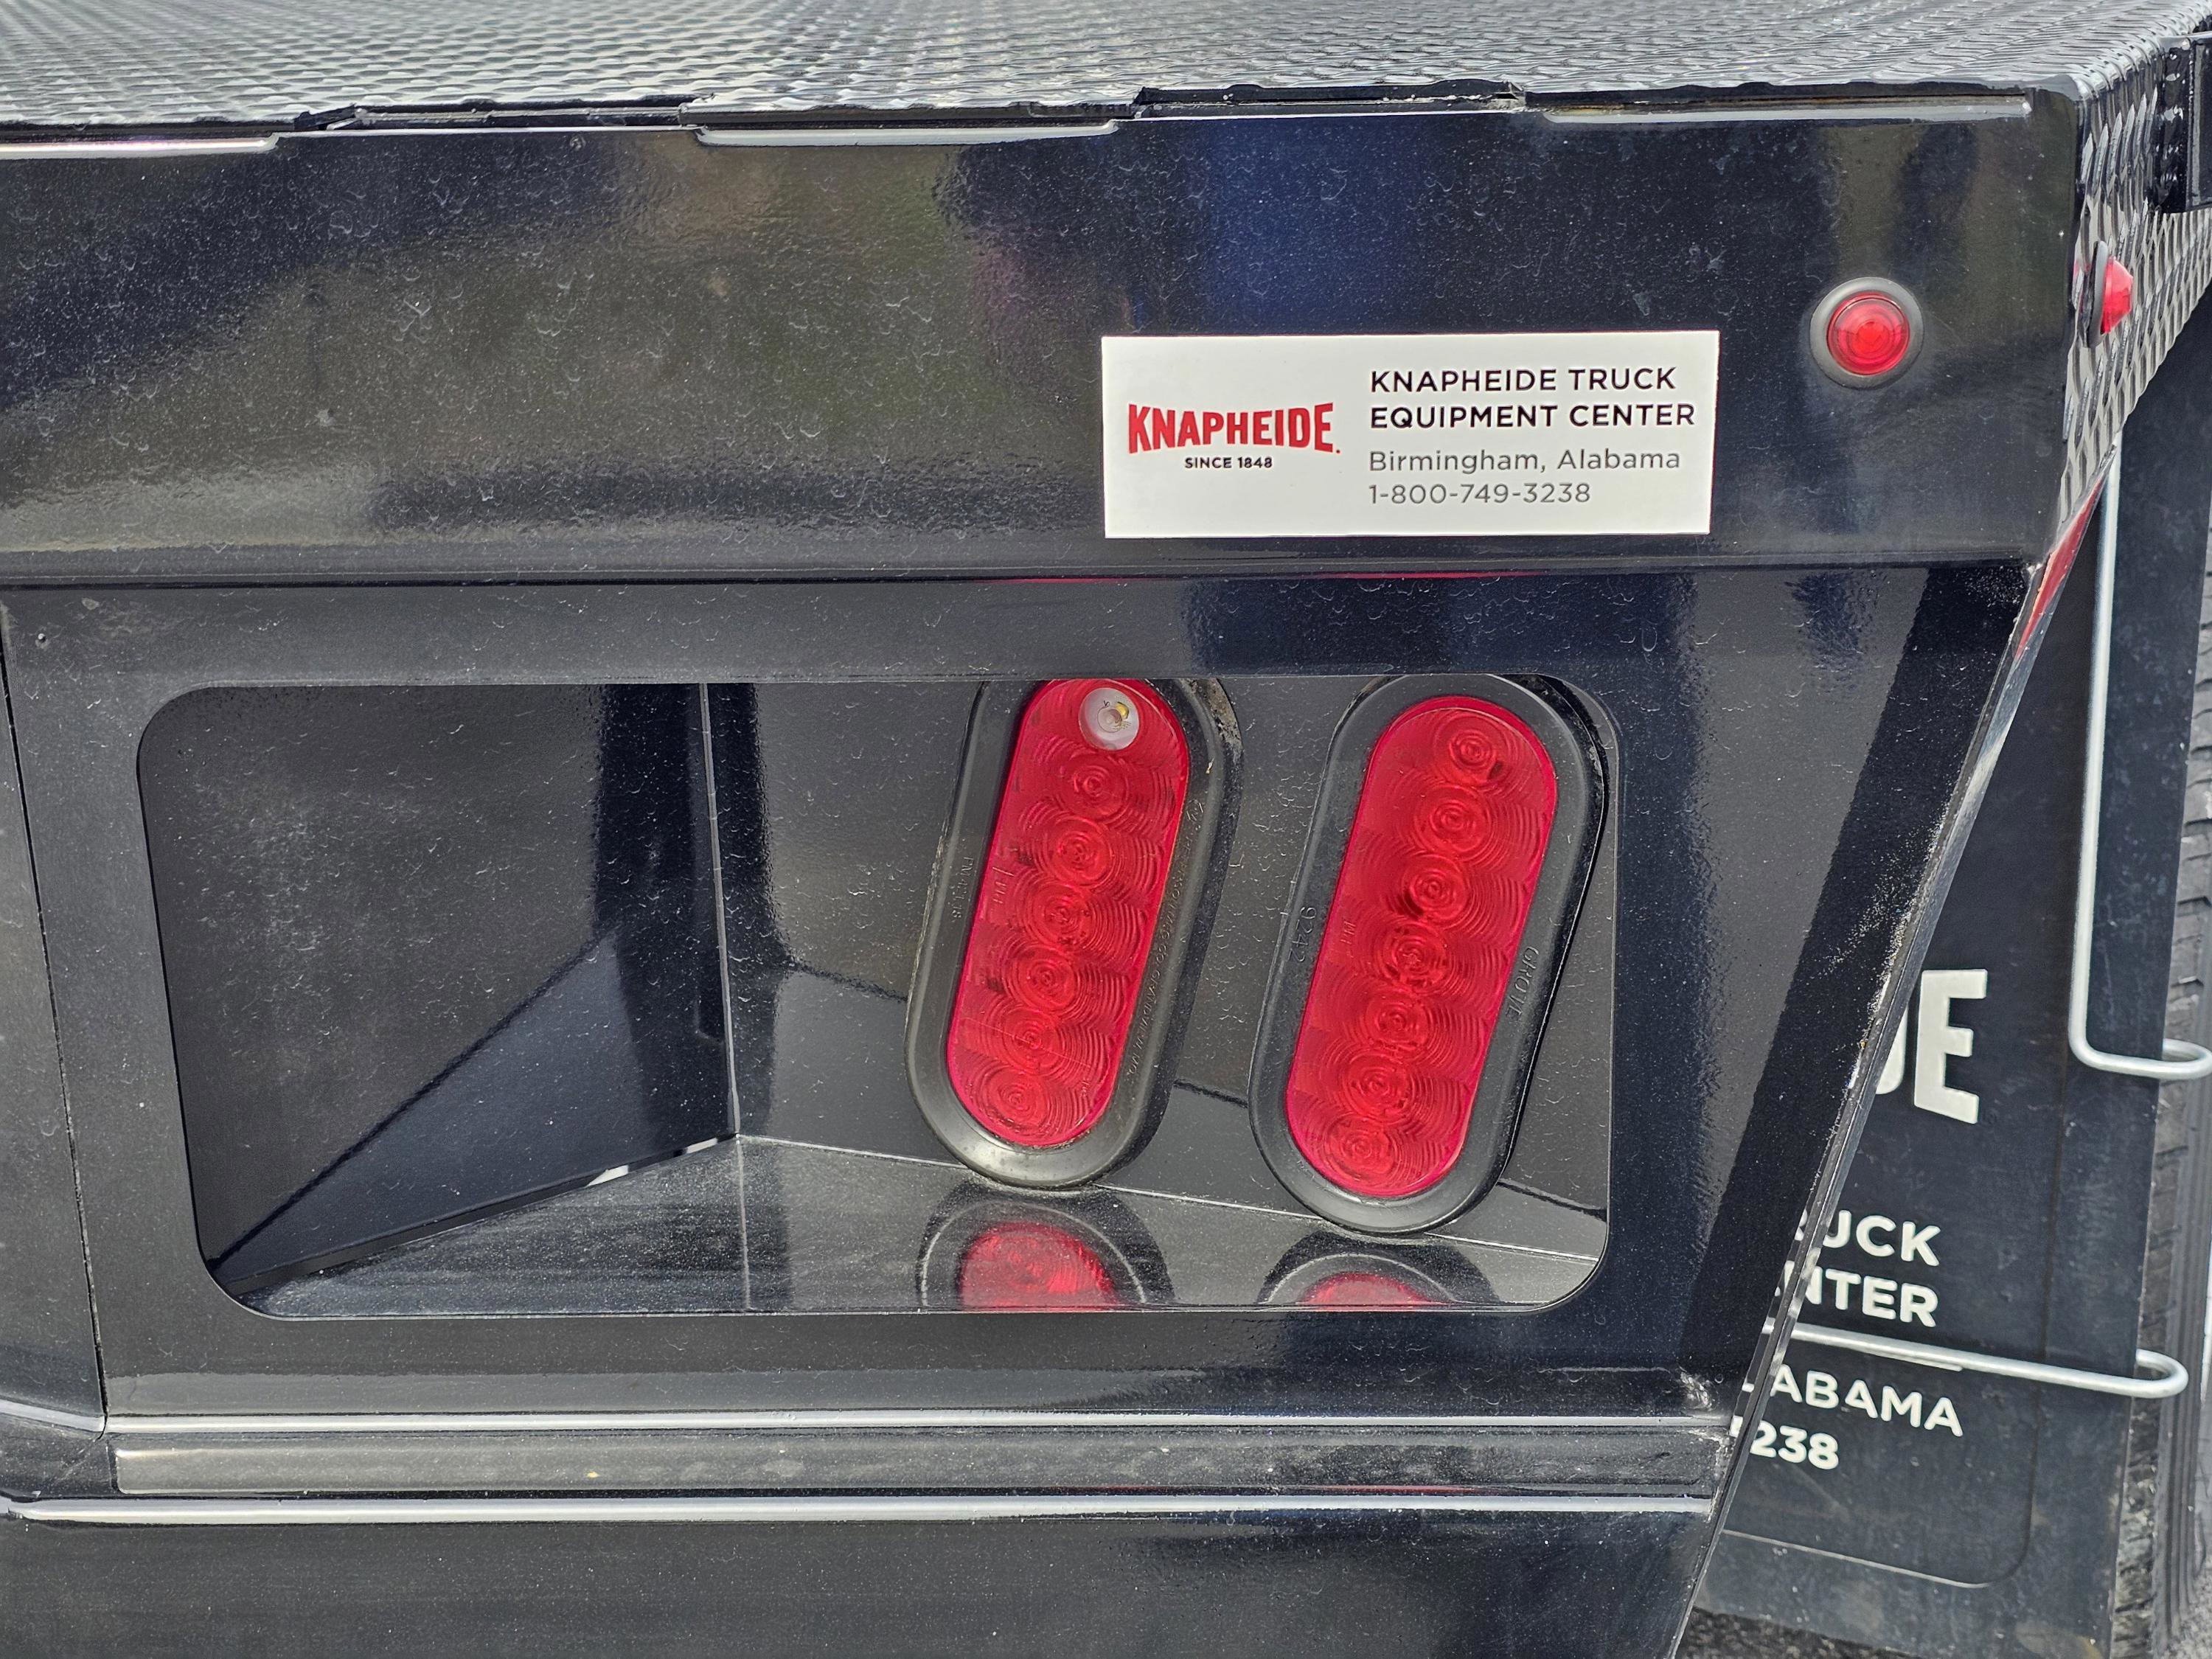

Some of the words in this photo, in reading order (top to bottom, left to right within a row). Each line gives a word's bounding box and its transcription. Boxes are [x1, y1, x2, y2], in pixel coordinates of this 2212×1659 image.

[1371, 369, 1556, 392] KNAPHEIDE
[1568, 367, 1675, 390] TRUCK
[1371, 406, 1558, 428] EQUIPMENT
[1570, 404, 1694, 427] CENTER
[1185, 456, 1232, 468] SINCE
[1237, 456, 1273, 468] 1848
[1370, 449, 1546, 474] Birmingham,
[1557, 448, 1680, 470] Alabama
[1368, 484, 1590, 504] 1-800-749-3238
[1287, 906, 1317, 962] 9242
[1742, 1364, 1963, 1437] ABAMA
[1730, 1415, 1839, 1470] 238
